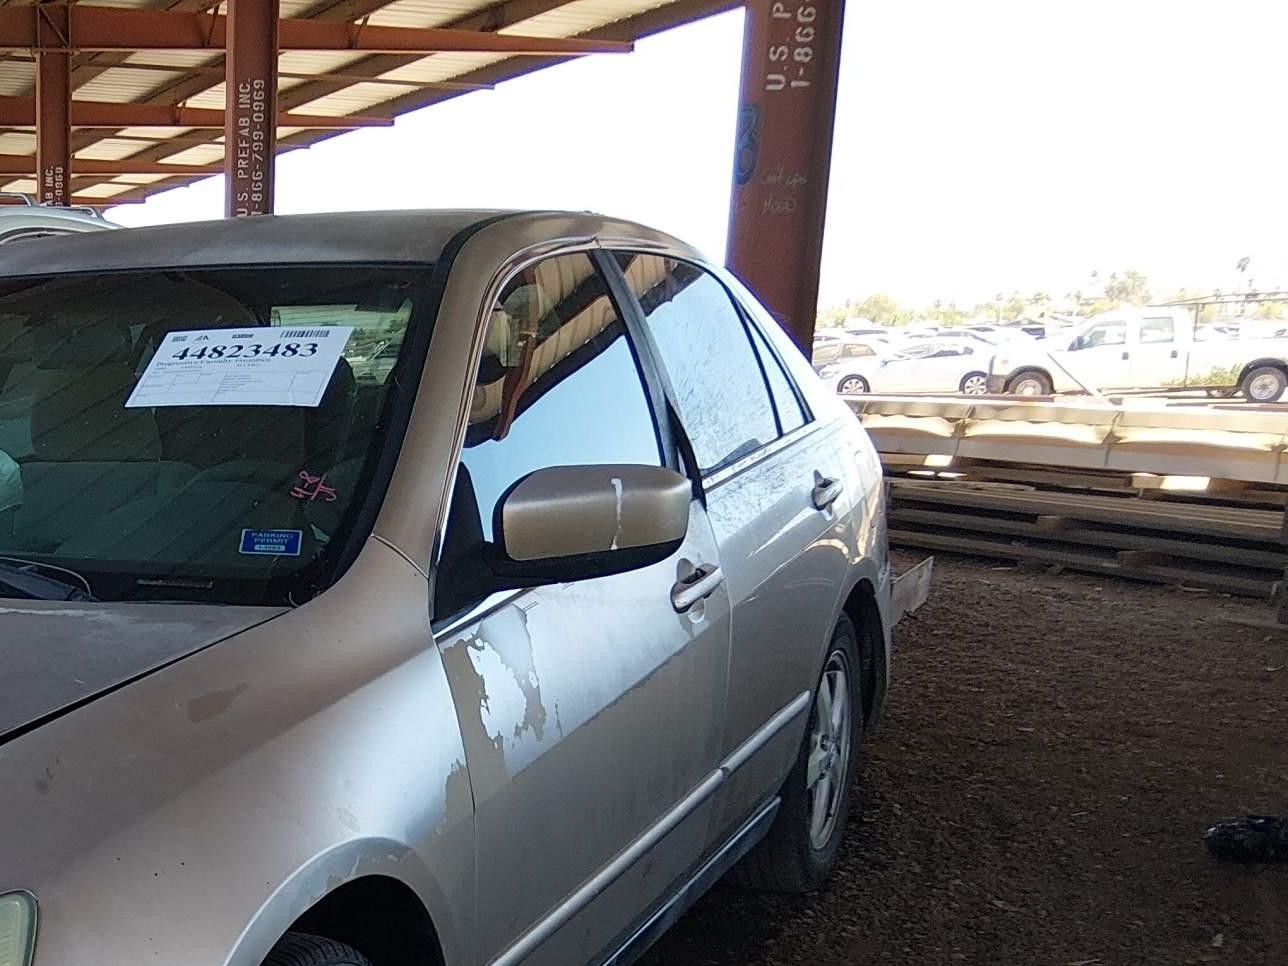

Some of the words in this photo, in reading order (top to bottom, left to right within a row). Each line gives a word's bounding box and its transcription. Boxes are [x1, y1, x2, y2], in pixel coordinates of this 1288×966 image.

[765, 37, 790, 91] U.S.
[238, 77, 251, 109] INC.
[237, 117, 250, 179] PREFAB
[251, 79, 265, 215] 1-866-799-0969
[44, 165, 54, 187] INC.
[172, 342, 319, 360] 44823483
